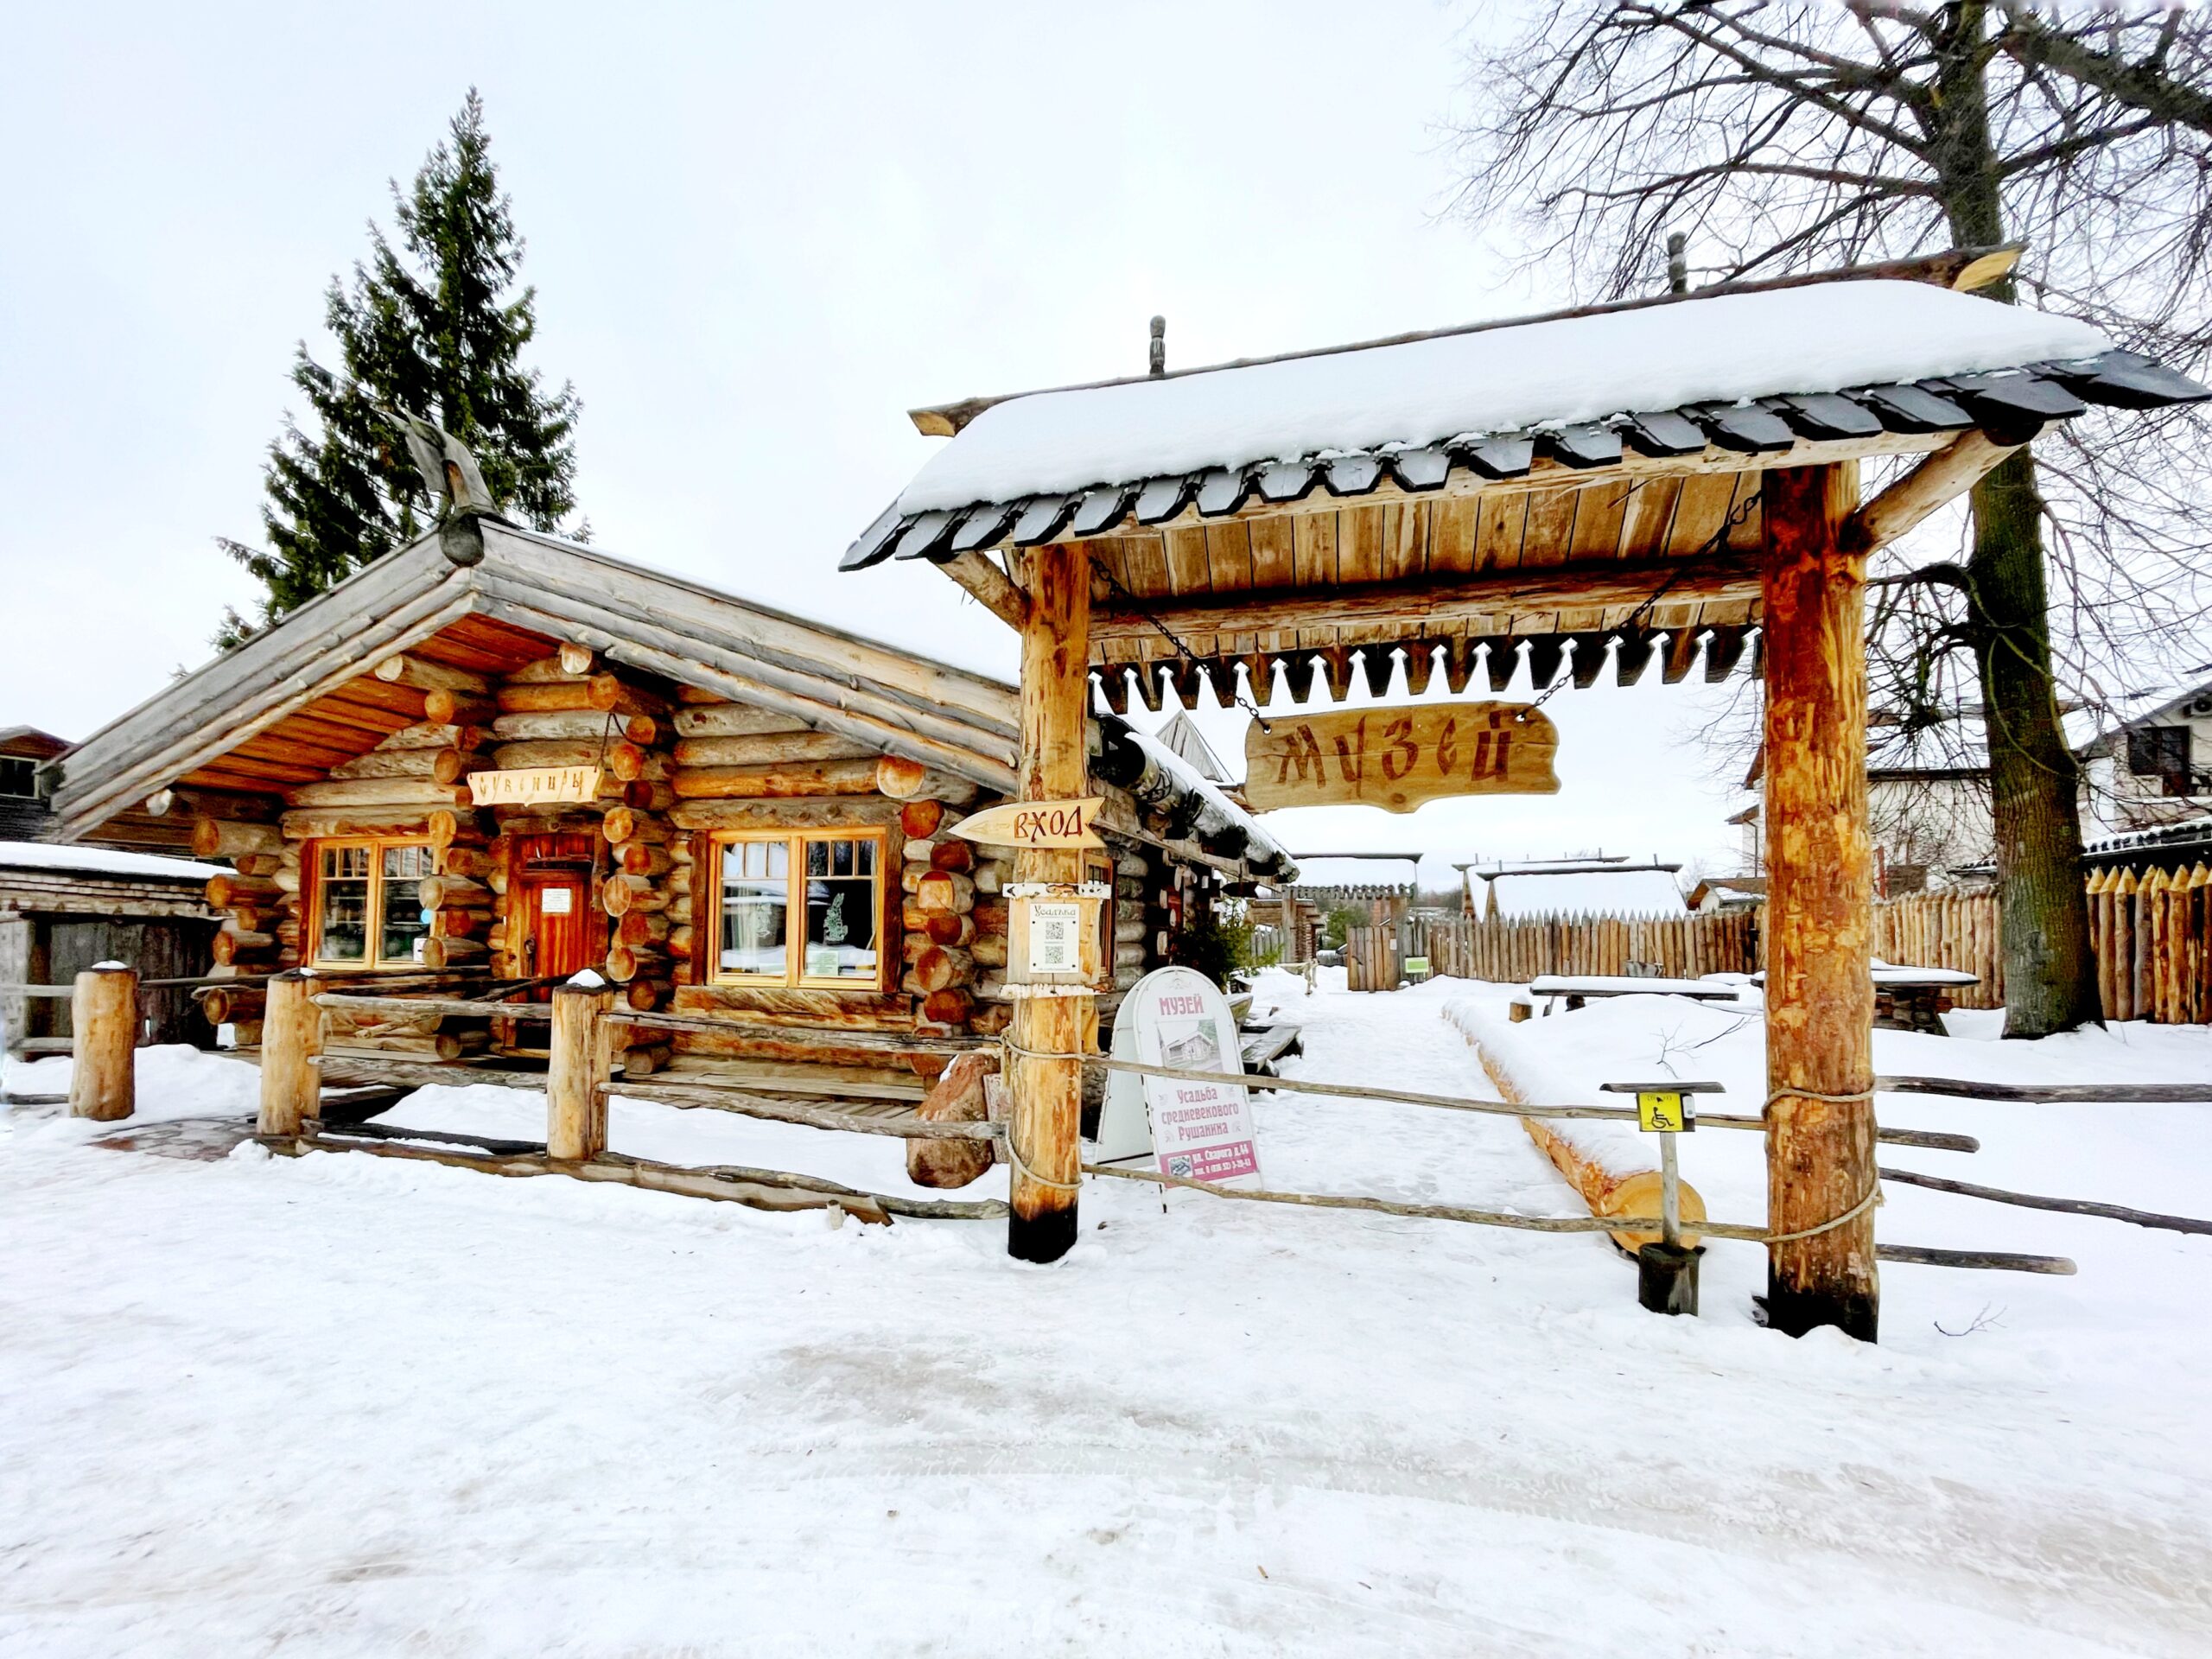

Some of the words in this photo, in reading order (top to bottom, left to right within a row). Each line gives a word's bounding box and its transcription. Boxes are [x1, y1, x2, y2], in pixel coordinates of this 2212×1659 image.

[1014, 805, 1084, 842] ВХОД
[1159, 994, 1205, 1016] МУЗЕЙ
[1177, 1087, 1218, 1104] Усадьба
[1161, 1103, 1239, 1125] средневекового
[1178, 1122, 1229, 1141] Рушанина
